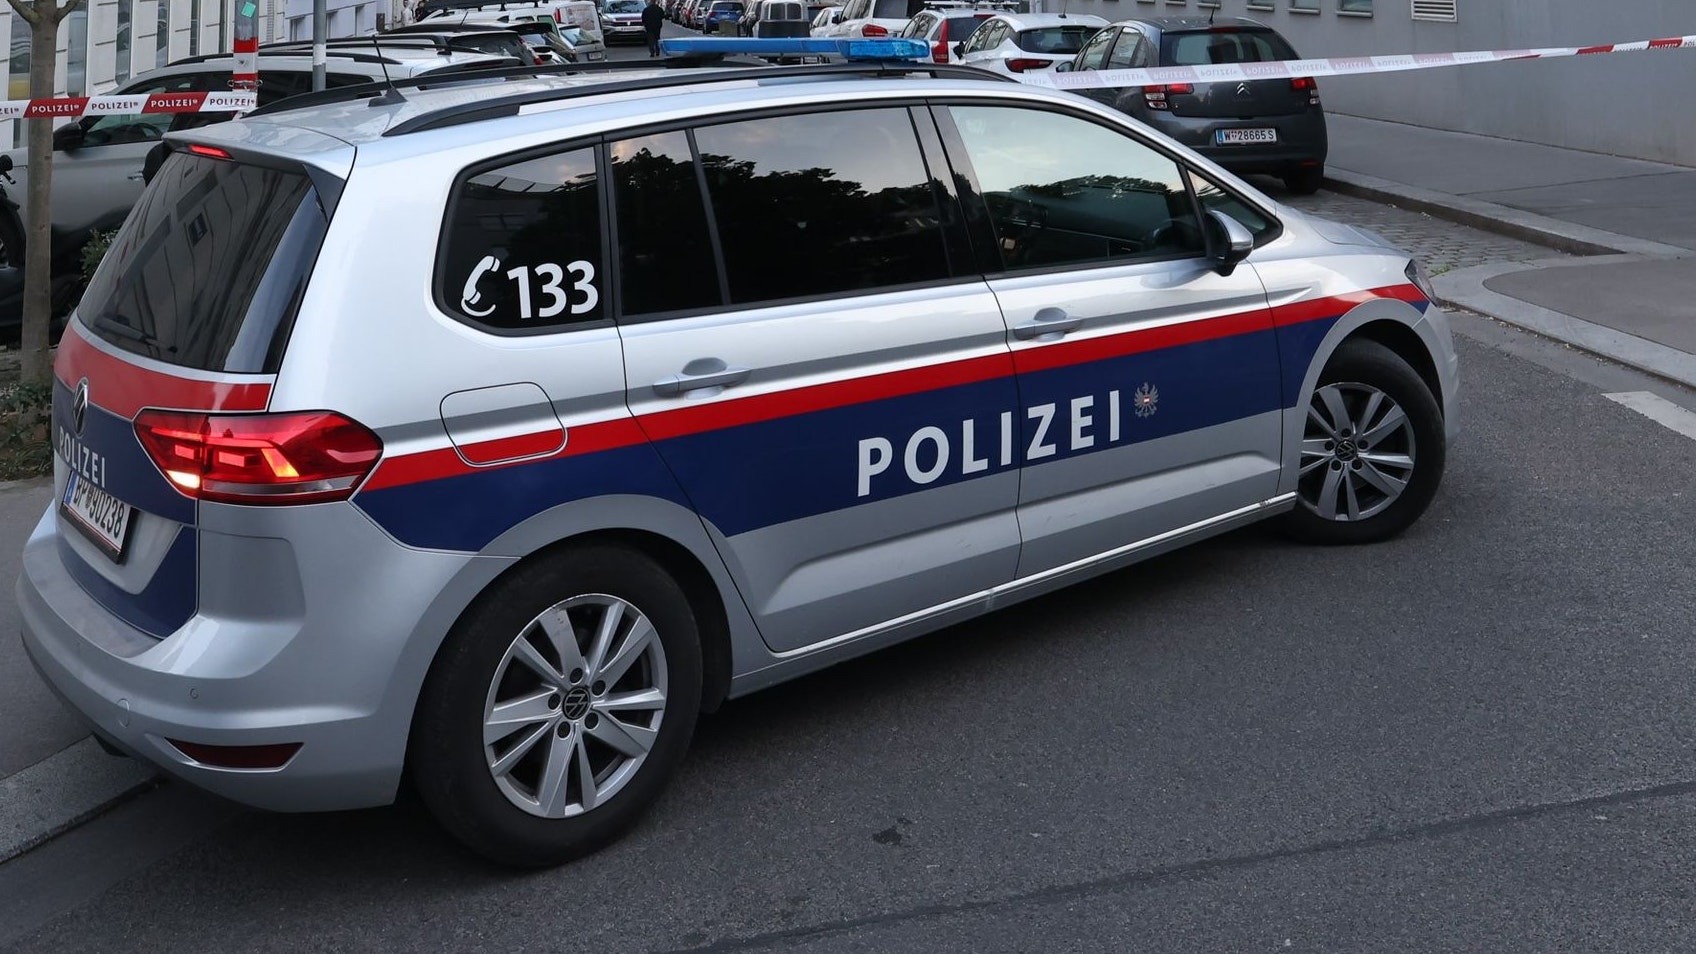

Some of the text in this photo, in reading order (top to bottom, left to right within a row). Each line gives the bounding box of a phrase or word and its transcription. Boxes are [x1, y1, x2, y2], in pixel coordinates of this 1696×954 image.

[31, 104, 74, 113] POLIZEI
[91, 101, 133, 110] POLIZEI
[151, 99, 192, 107] POLIZEI
[210, 98, 250, 106] POLIZEI
[1238, 130, 1266, 140] 28665
[506, 260, 599, 319] 133
[59, 426, 106, 489] POLIZEI
[857, 390, 1120, 497] POLIZEI
[88, 490, 125, 539] 90238
